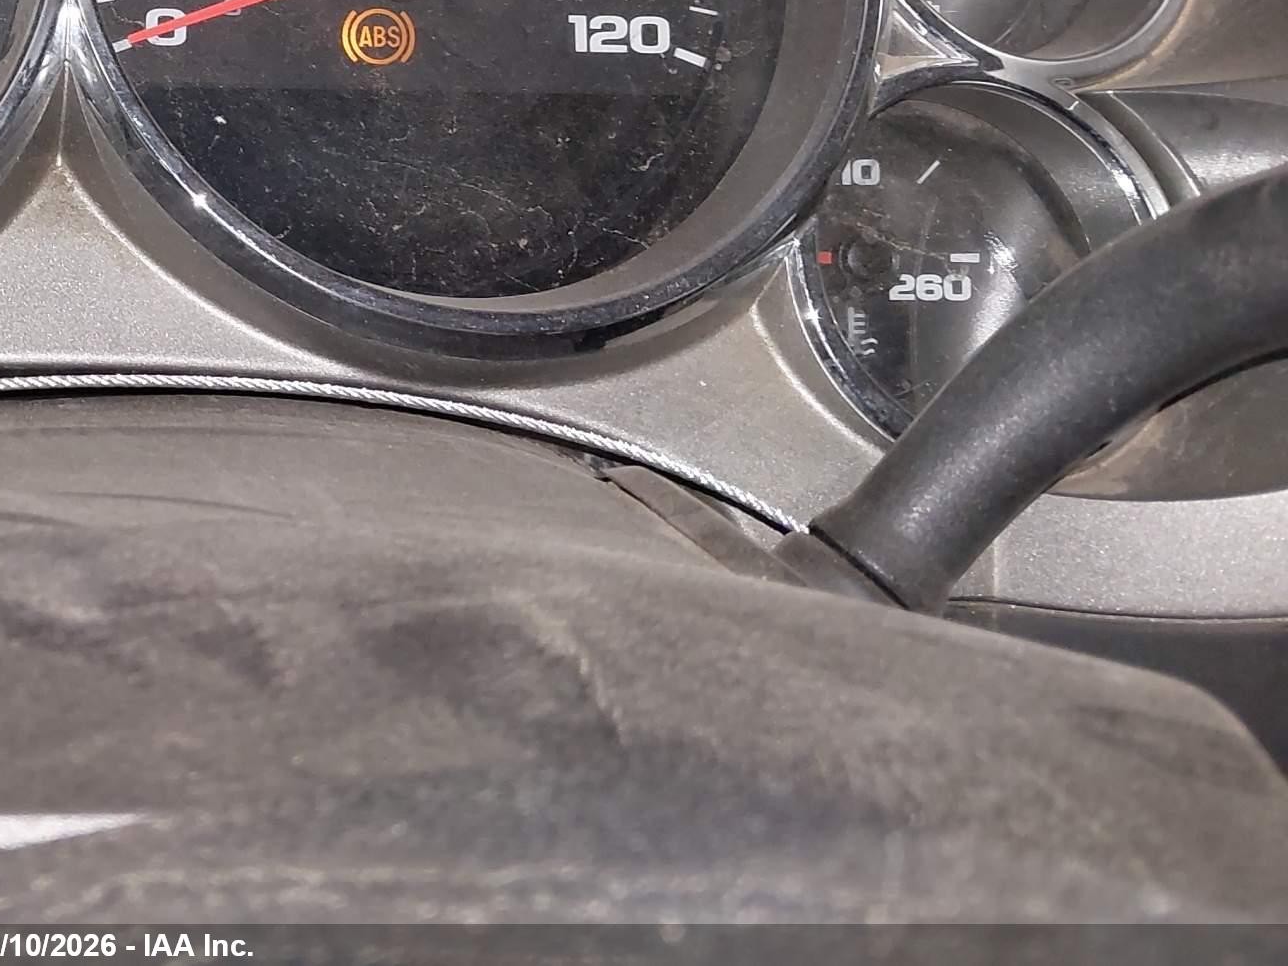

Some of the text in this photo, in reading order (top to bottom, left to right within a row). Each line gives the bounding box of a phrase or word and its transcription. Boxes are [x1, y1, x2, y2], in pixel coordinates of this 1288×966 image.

[358, 25, 401, 49] ABS
[567, 14, 671, 54] 120
[889, 273, 972, 302] 260
